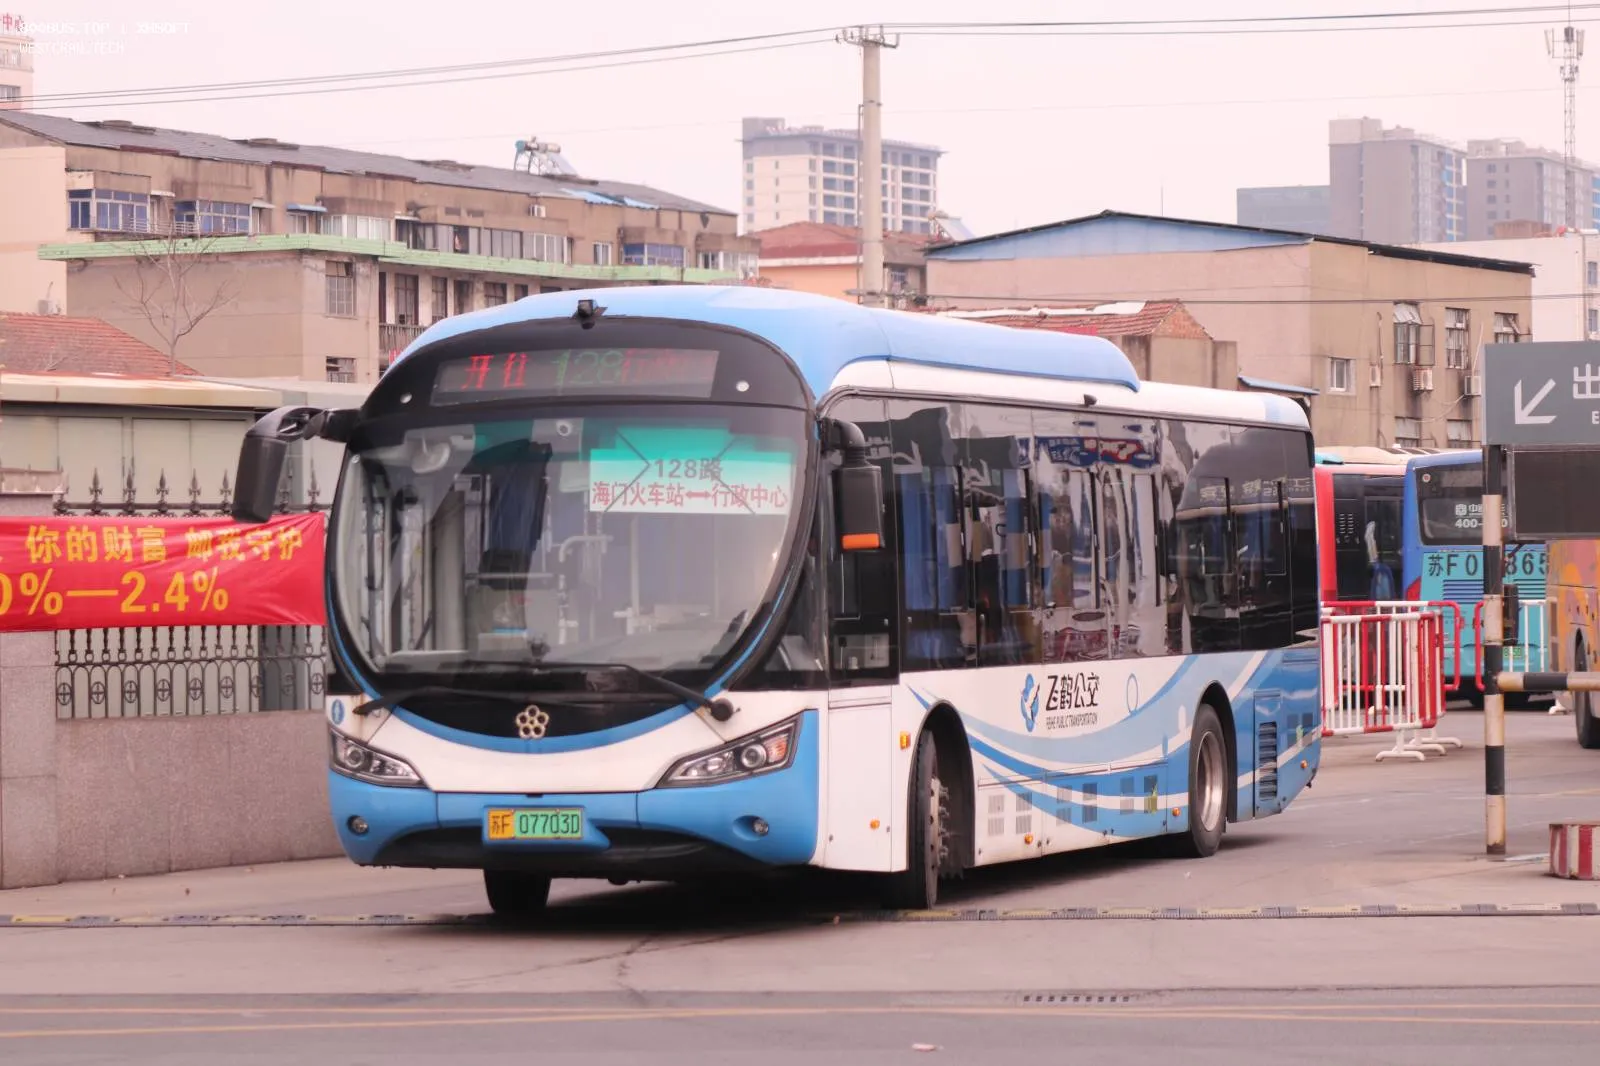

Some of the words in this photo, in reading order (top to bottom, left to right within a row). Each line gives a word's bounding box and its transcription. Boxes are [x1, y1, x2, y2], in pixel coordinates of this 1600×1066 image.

[654, 457, 723, 480] 128路
[592, 481, 685, 507] 海门火车站
[711, 482, 789, 509] 行政中心
[25, 524, 167, 564] 你的财富
